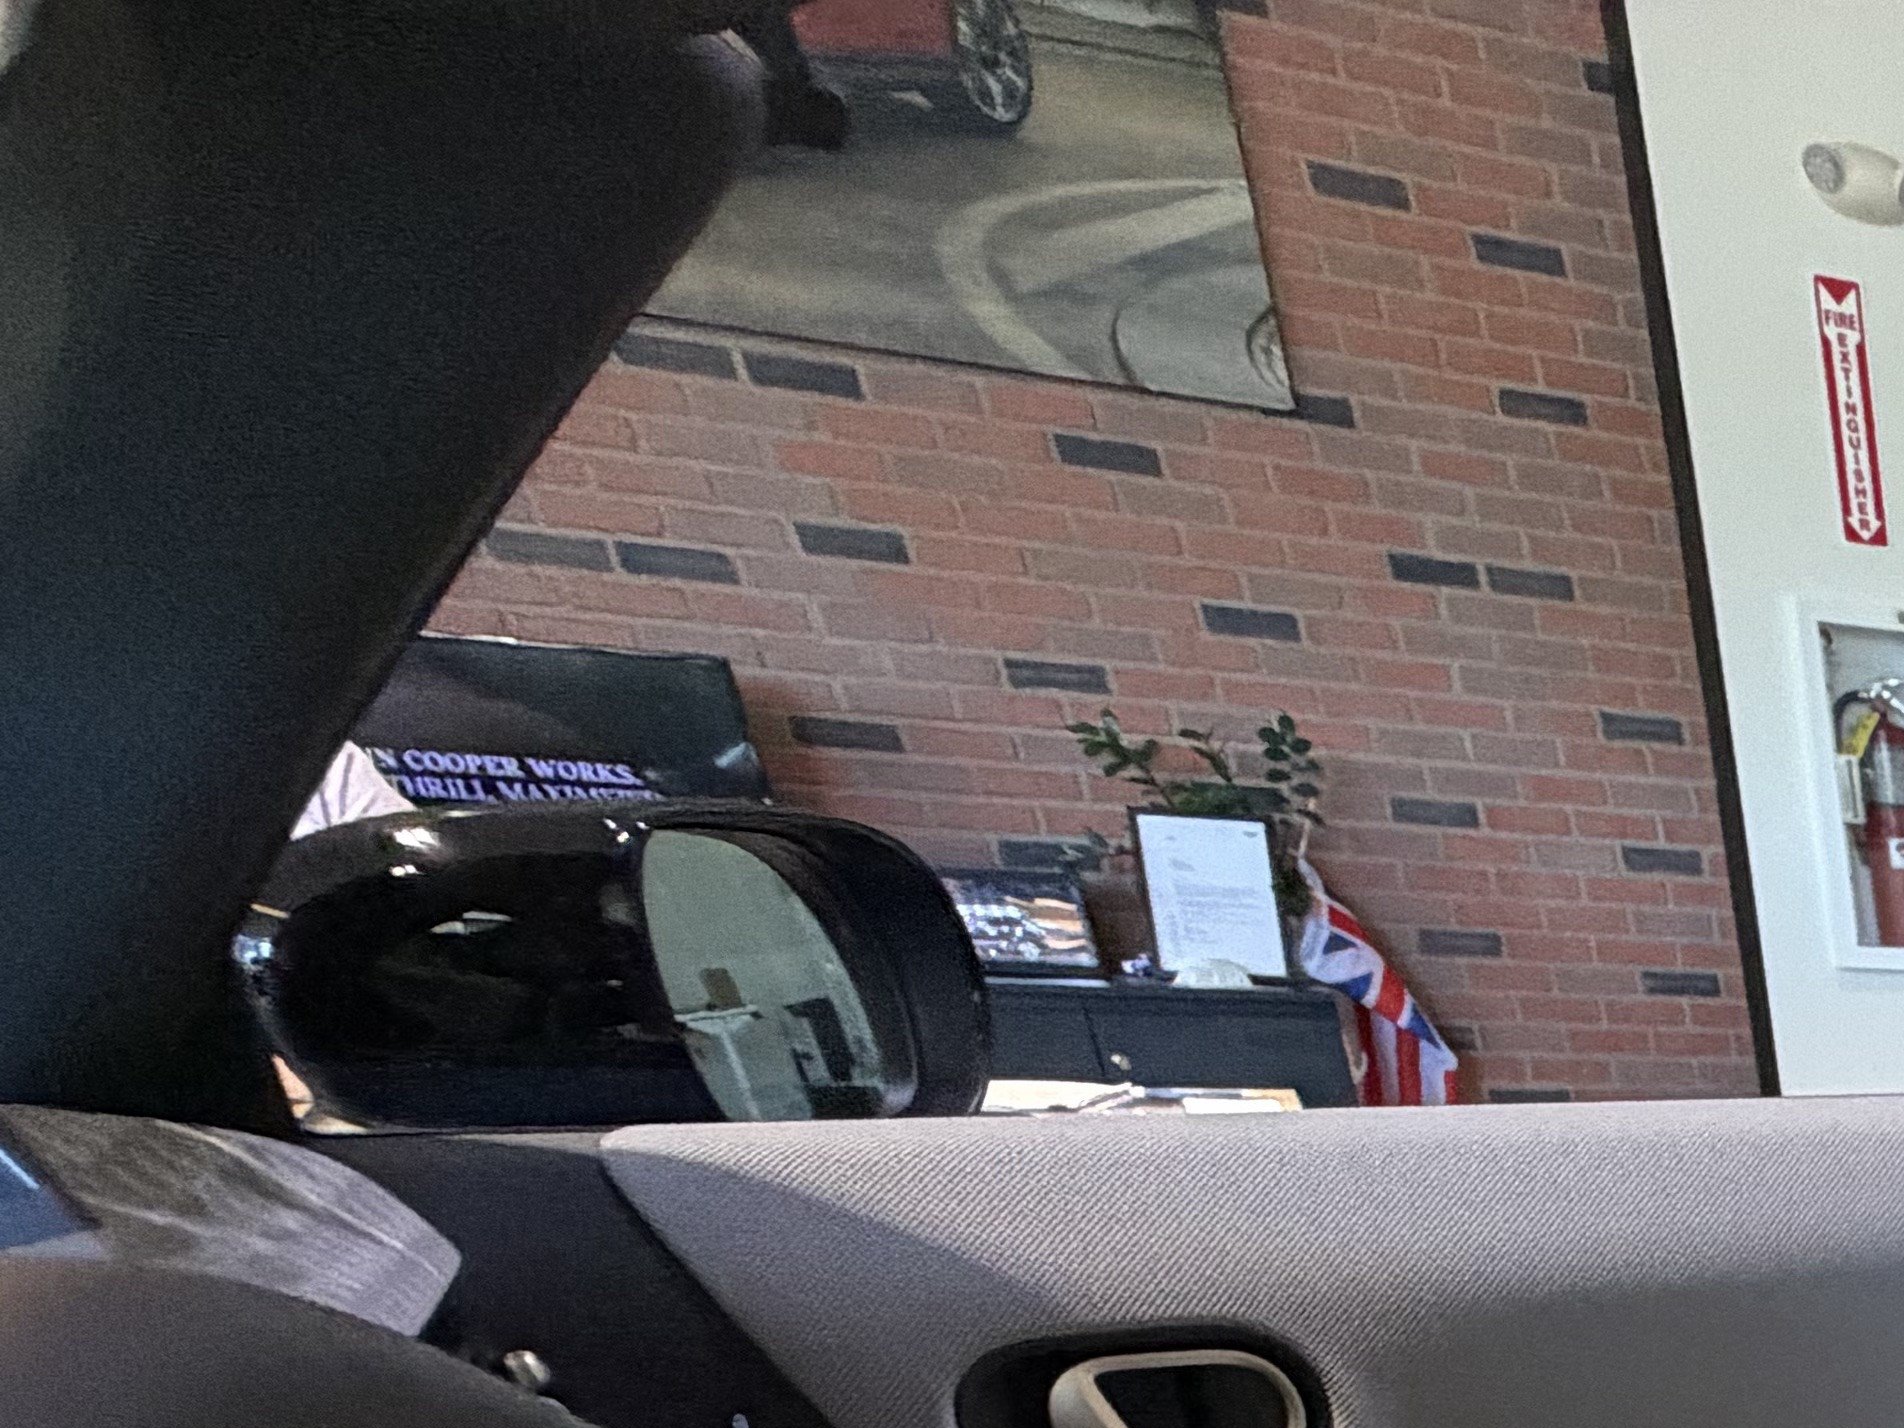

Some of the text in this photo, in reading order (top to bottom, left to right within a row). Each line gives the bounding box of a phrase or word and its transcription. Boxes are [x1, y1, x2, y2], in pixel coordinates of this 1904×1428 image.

[1823, 308, 1858, 332] FIRE
[1836, 332, 1872, 532] EXTINGUISHER
[402, 748, 526, 778] COOPER
